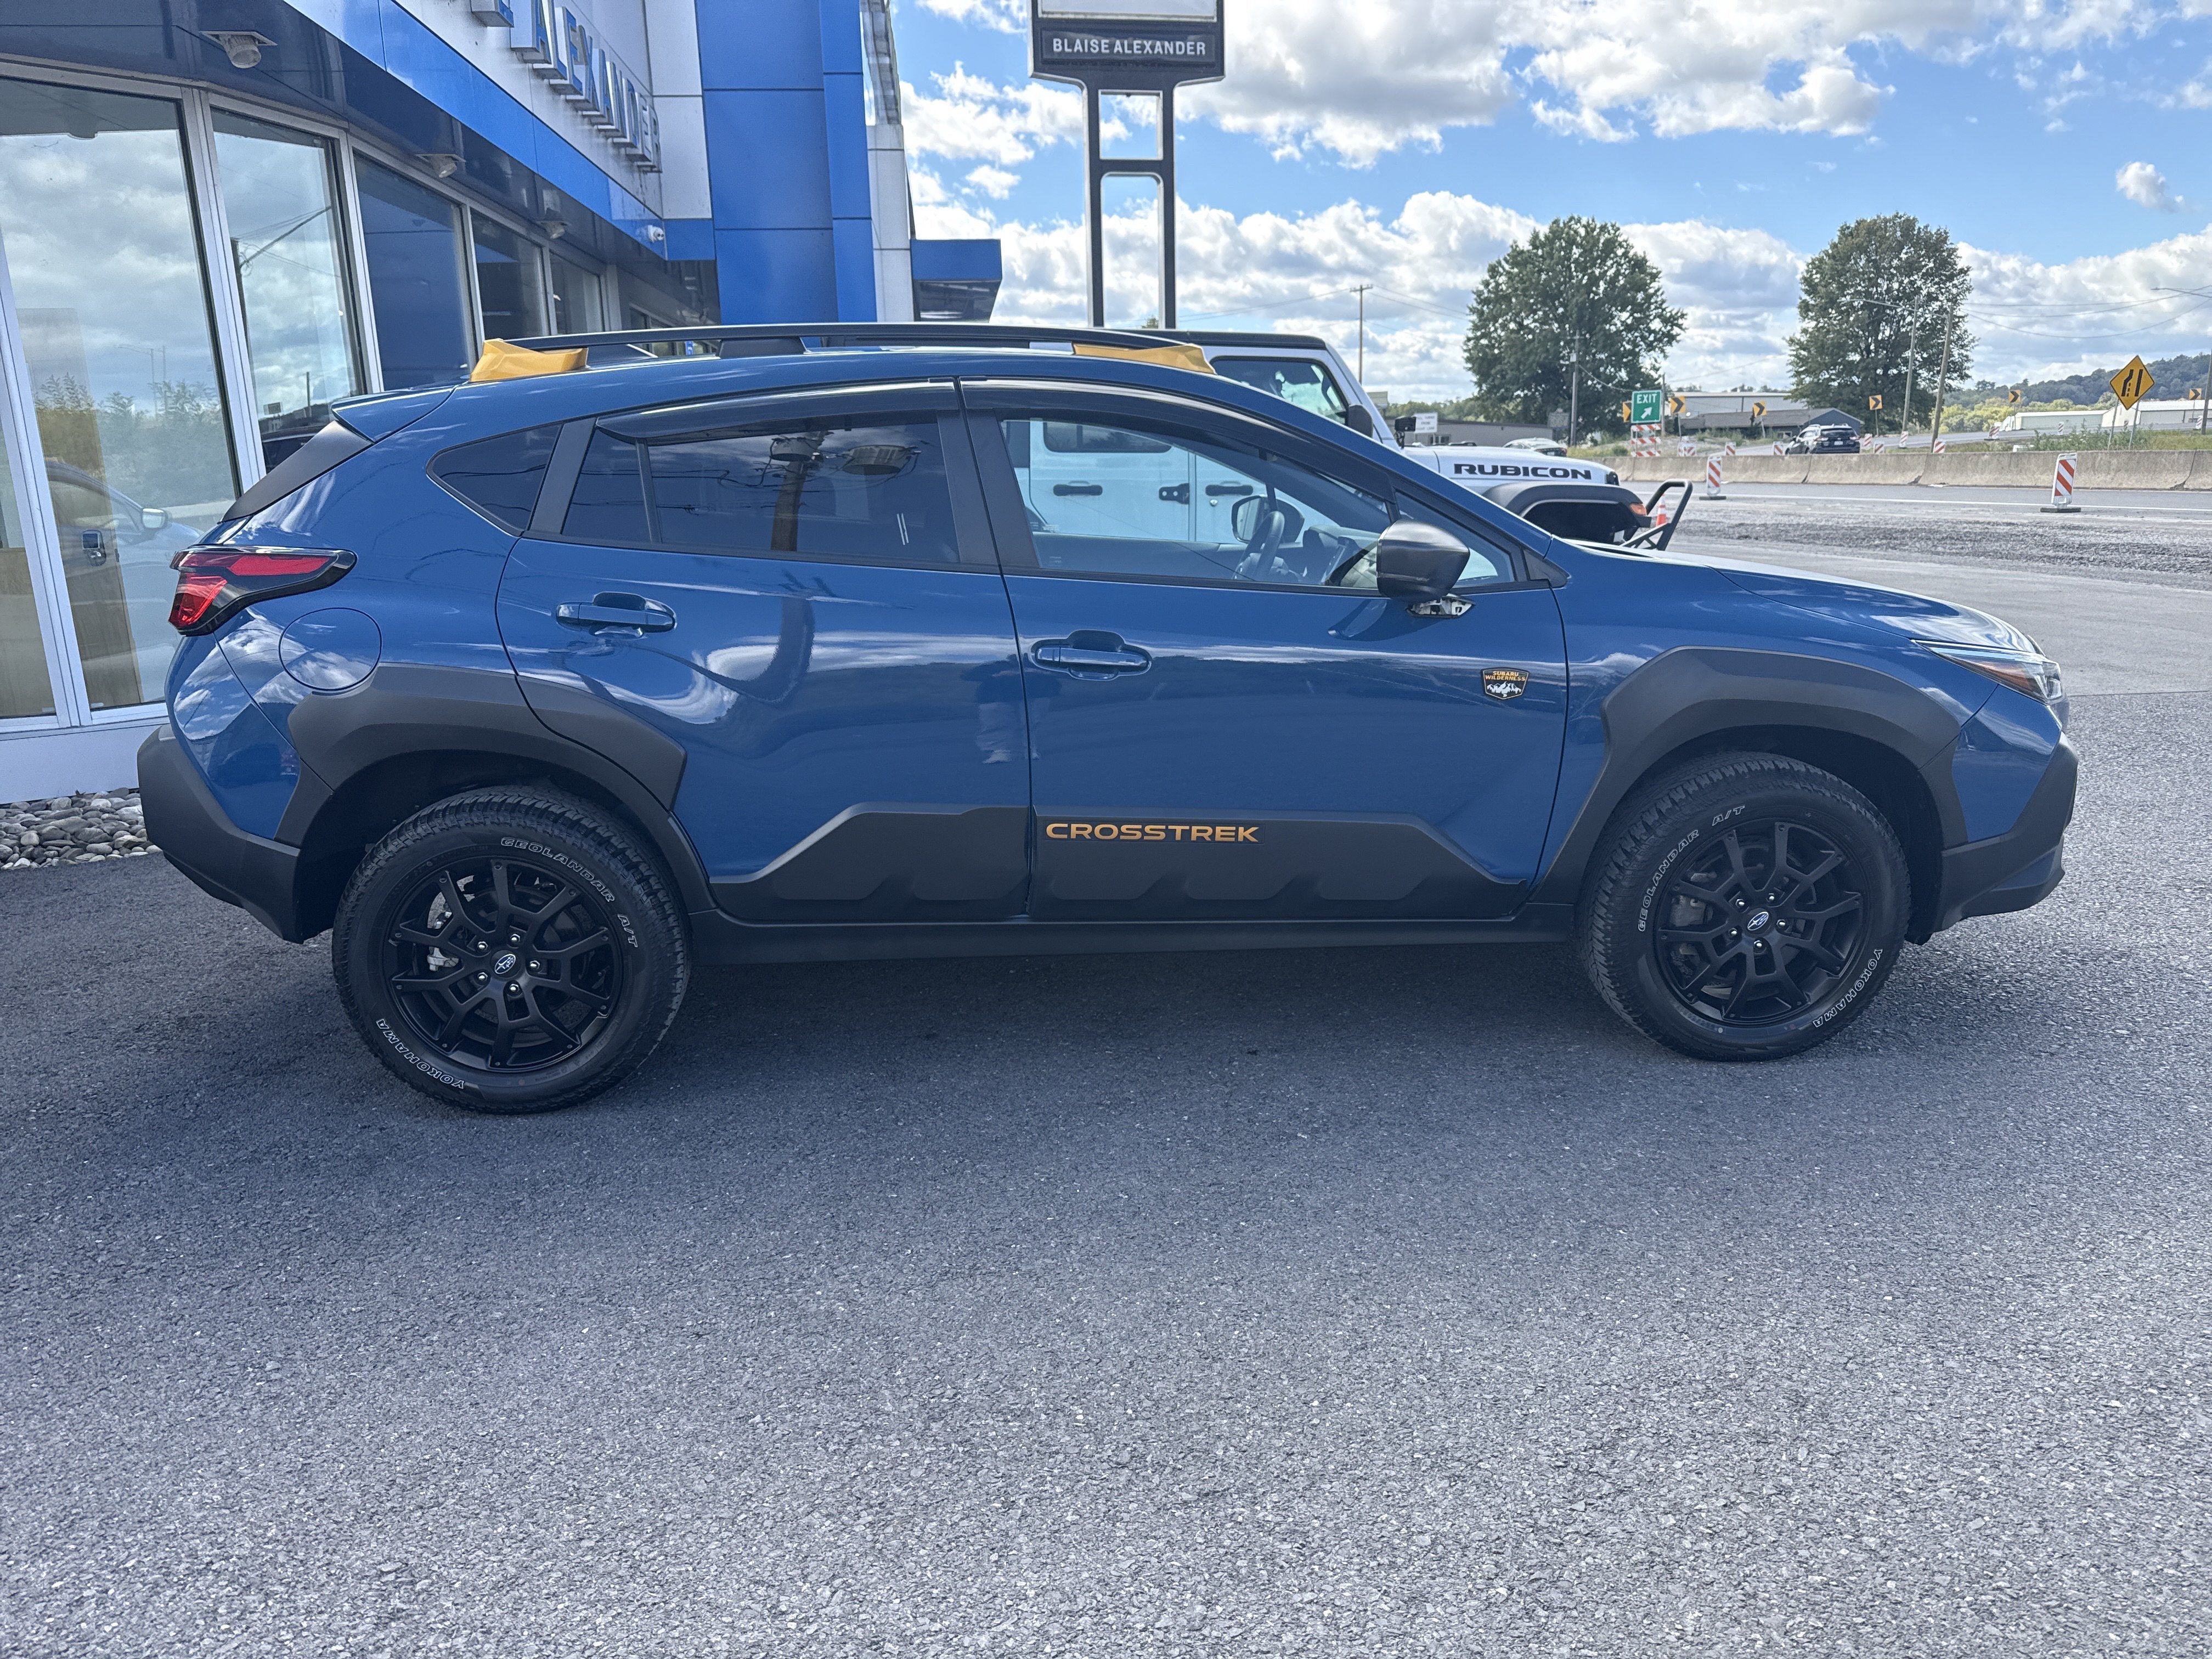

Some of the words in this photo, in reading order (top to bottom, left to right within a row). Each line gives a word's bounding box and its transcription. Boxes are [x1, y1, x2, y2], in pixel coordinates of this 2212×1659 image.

[1052, 37, 1109, 53] BLAISE
[1113, 40, 1206, 55] ALEXANDER
[1637, 393, 1657, 404] EXIT
[1453, 463, 1592, 480] RUBICON
[1046, 823, 1260, 842] CROSSTREK
[1638, 830, 1700, 932] GEOLANDAR
[1712, 805, 1745, 826] A/T
[500, 837, 615, 902] GEOLANDAR
[617, 913, 638, 949] A/T
[1812, 948, 1883, 1028] YOKOHAMA
[376, 1018, 466, 1090] YOKOHAMA
